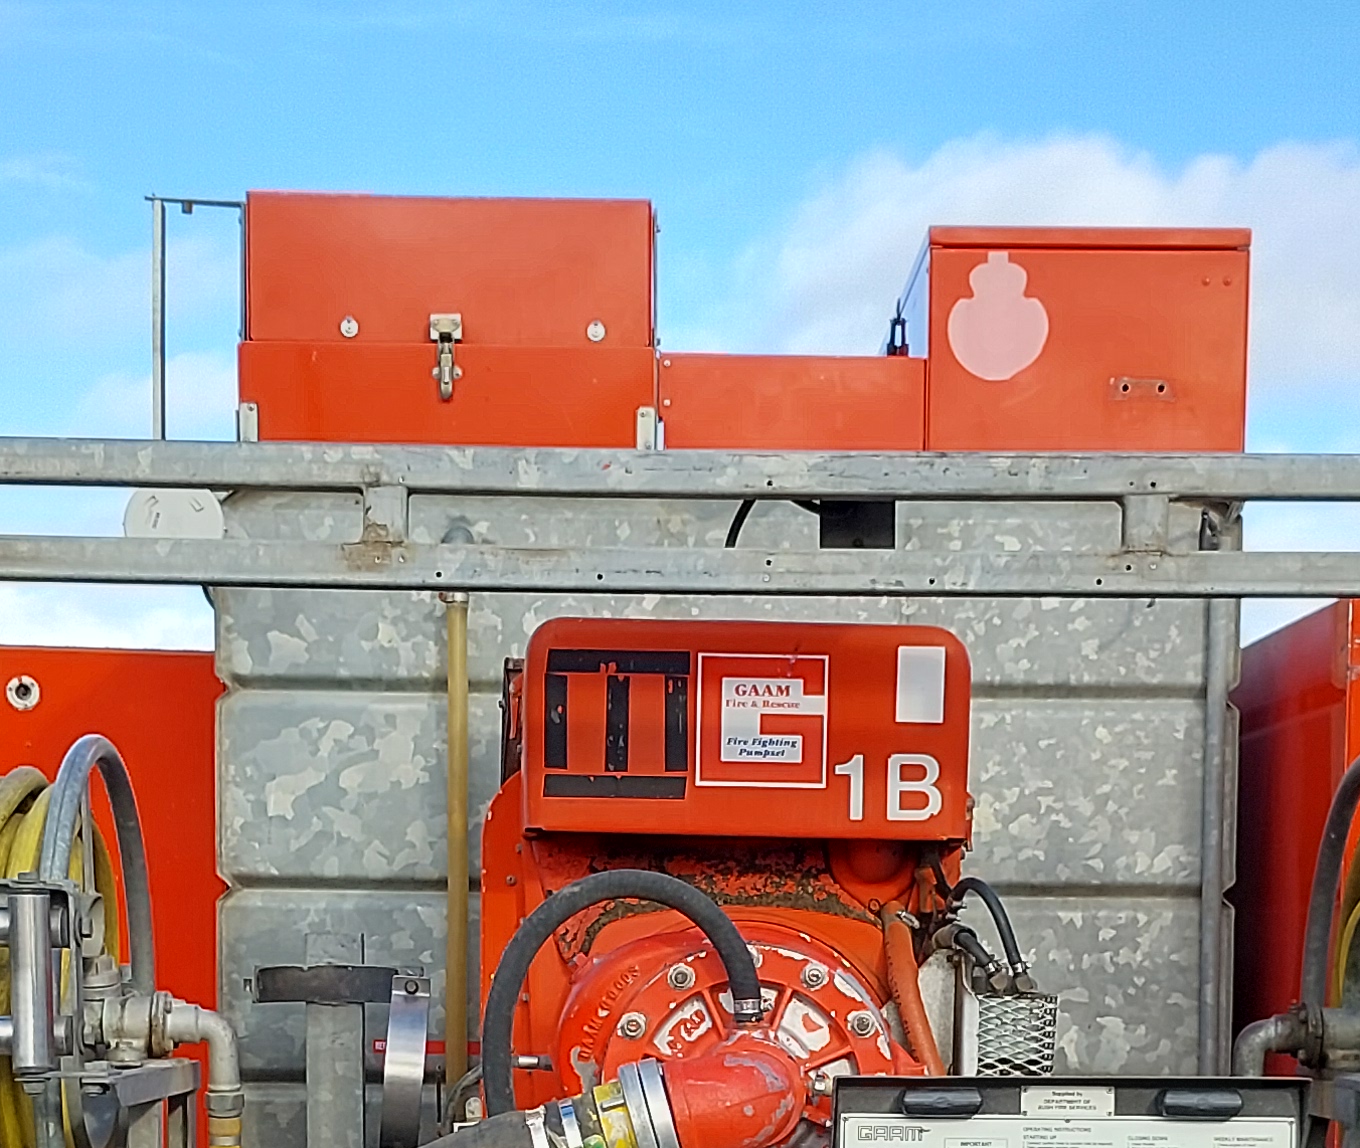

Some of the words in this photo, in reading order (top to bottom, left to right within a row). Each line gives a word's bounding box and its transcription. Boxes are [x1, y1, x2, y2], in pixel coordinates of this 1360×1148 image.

[734, 684, 791, 697] GAAM
[725, 699, 748, 708] Fire
[761, 700, 801, 709] Rescue
[726, 737, 749, 746] Fire
[751, 738, 798, 748] Fighting
[738, 748, 785, 758] Pumpset
[835, 753, 943, 820] 1B
[857, 1125, 924, 1141] GAAM
